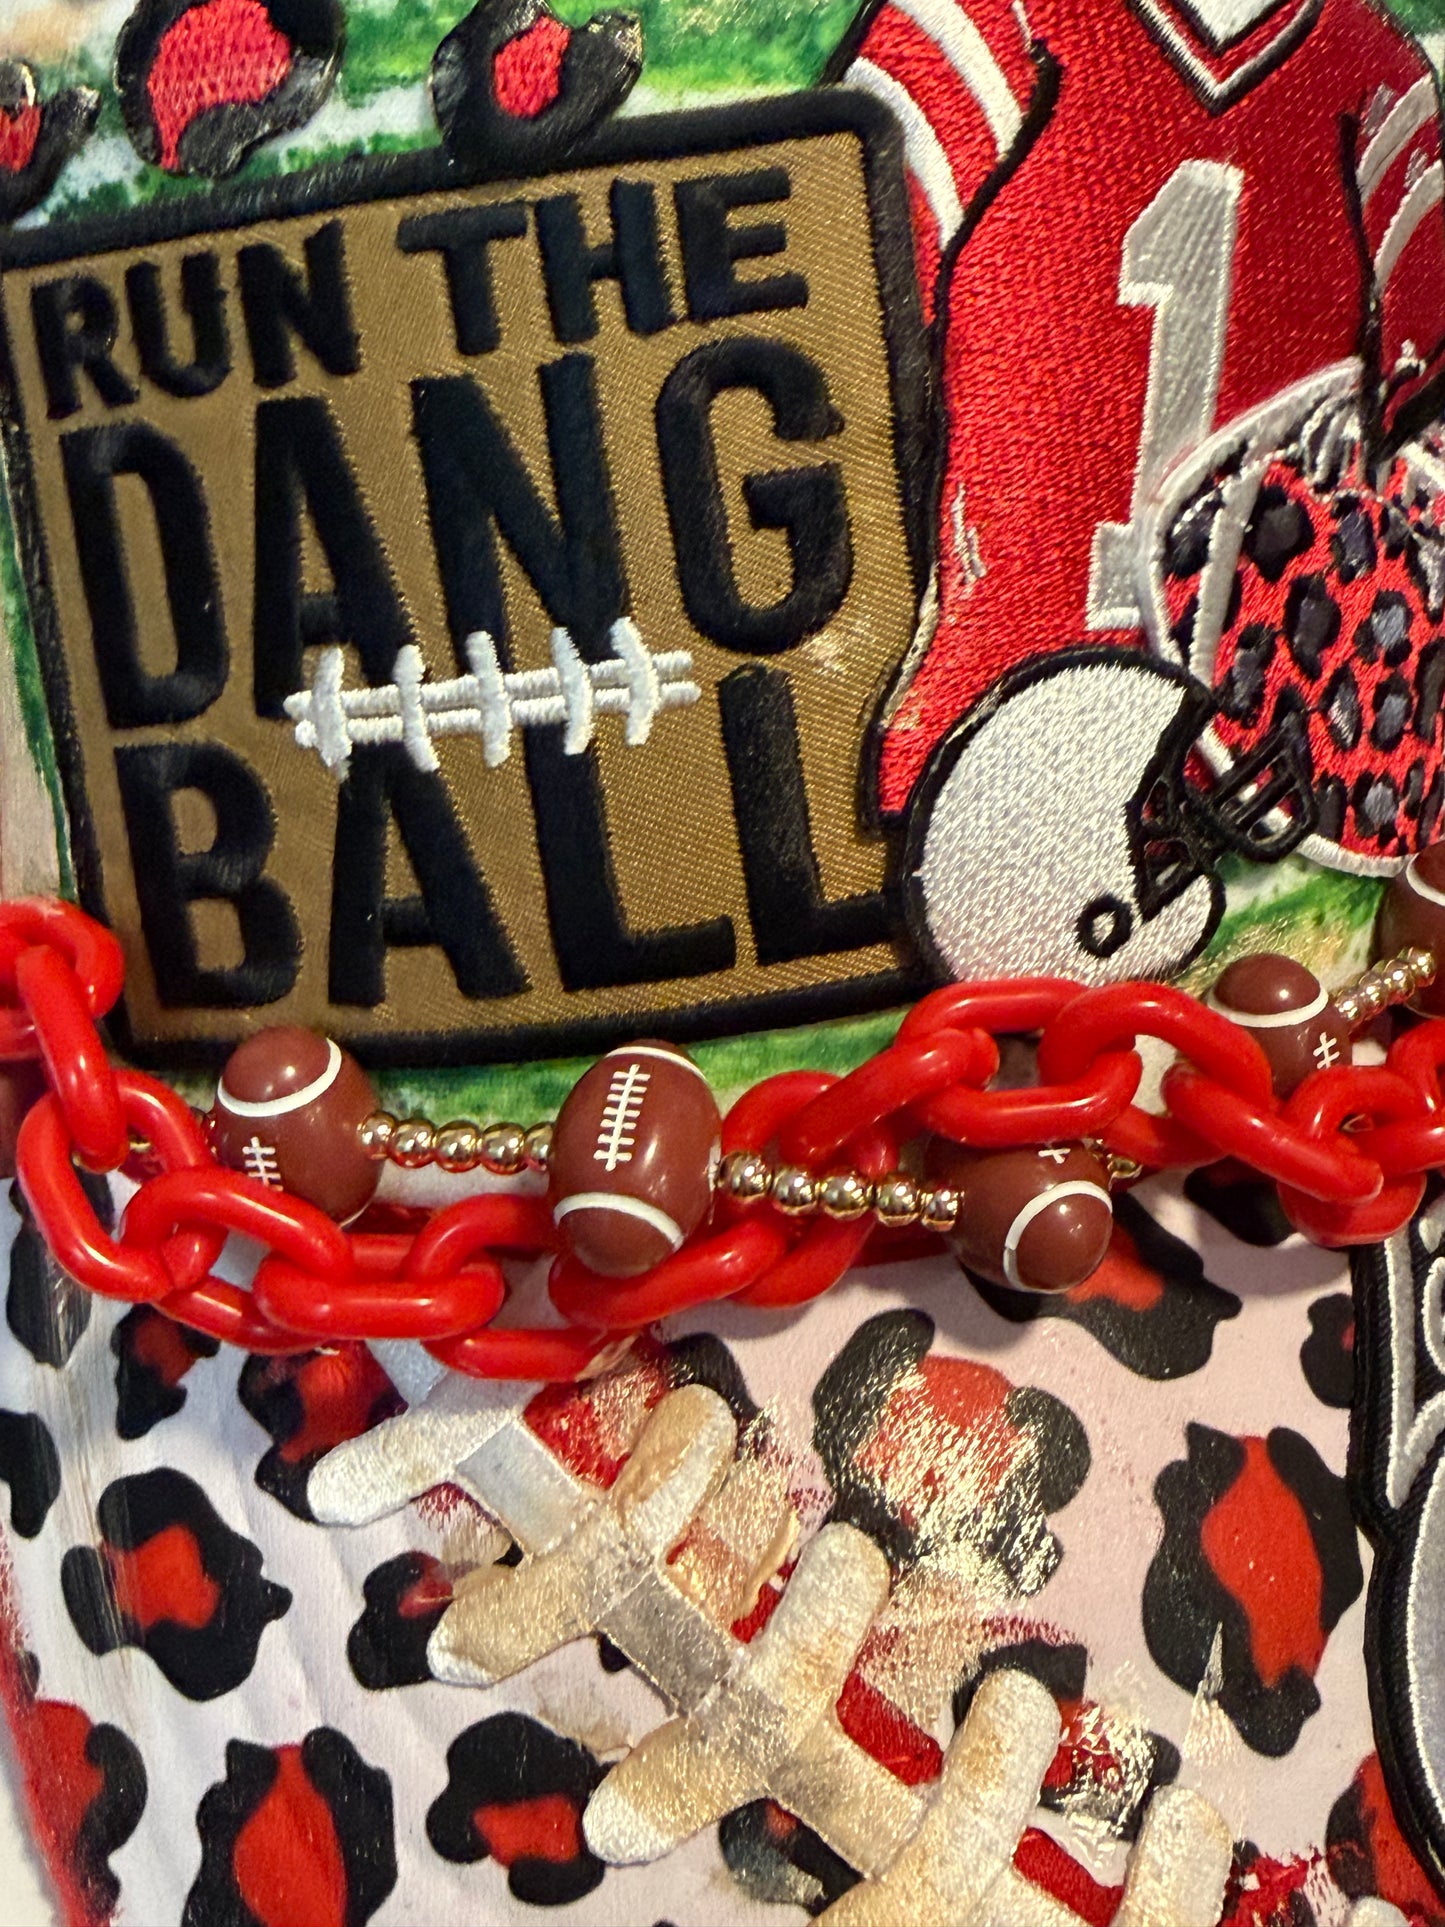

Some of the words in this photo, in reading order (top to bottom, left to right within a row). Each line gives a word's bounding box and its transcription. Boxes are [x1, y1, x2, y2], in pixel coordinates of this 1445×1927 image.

[31, 217, 363, 419] RUN
[399, 167, 809, 356] THE
[1086, 158, 1244, 630] 1
[61, 337, 856, 727] DANG
[114, 662, 890, 1008] BALL
